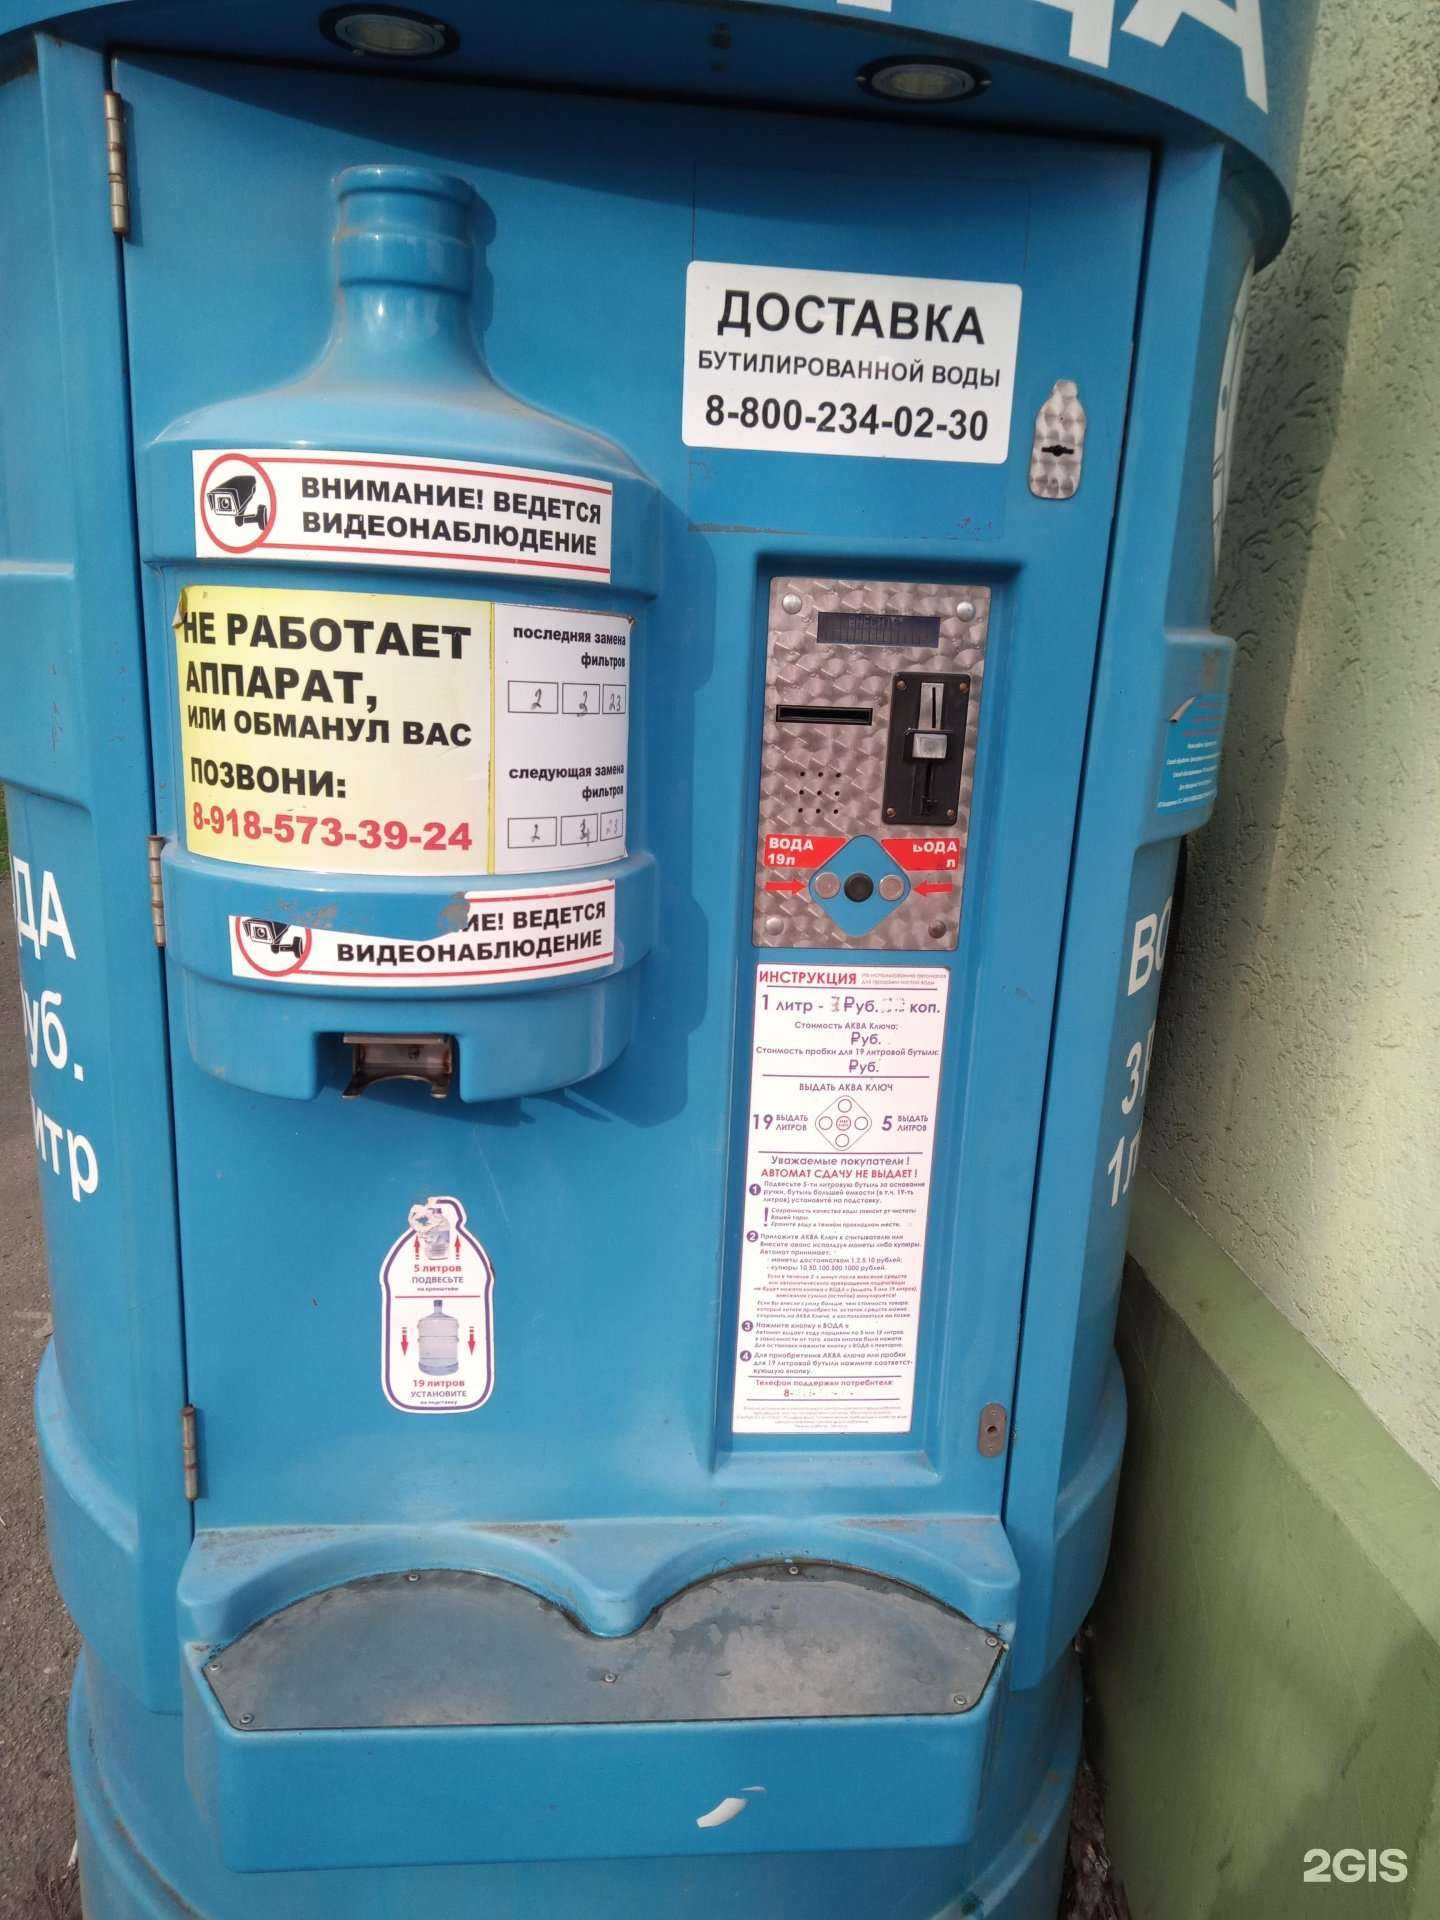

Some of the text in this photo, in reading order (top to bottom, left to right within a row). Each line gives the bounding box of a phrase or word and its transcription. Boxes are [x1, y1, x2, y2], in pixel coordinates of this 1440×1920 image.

[717, 289, 985, 345] ДОСТАВКА
[698, 350, 1000, 389] БУТИЛИРОВАННОЙ ВОДЫ
[705, 394, 988, 442] 8-800-234-02-30
[301, 476, 602, 525] ВНИМАНИЕ! ВЕДЕТСЯ
[302, 511, 597, 556] ВИДЕОНАБЛЮДЕНИЕ
[182, 611, 471, 660] НЕ РАБОТАЕТ
[513, 626, 626, 646] последняя замена
[581, 651, 626, 670] фильтров
[186, 660, 377, 713] АППАРАТ,
[187, 705, 472, 748] ИЛИ ОБМАНУЛ ВАС
[190, 756, 347, 799] ПОЗВОНИ:
[508, 763, 625, 781] следующая замена
[582, 785, 624, 802] фильтров
[193, 801, 473, 851] 8-918-573-39-24
[768, 837, 814, 852] ВОДА
[767, 853, 796, 866] 19л
[513, 901, 606, 930] ВЕДЕТСЯ
[337, 929, 602, 967] ВИДЕОНАБЛЮДЕНИЕ
[759, 971, 857, 985] ИНСТРУКЦИЯ
[762, 994, 769, 1011] 1
[776, 1001, 813, 1014] литр
[910, 1002, 941, 1014] коп.
[794, 1021, 843, 1031] Стоимость
[845, 1021, 867, 1031] АКВА
[756, 1046, 804, 1056] Стоимость
[805, 1047, 837, 1057] пробки
[866, 1048, 906, 1057] литровой
[799, 1083, 894, 1093] ВЫДАТЬ АКВА КЛЮЧ
[753, 1113, 809, 1131] 19 ВЫДАТЬ
[776, 1123, 807, 1132] ЛИТРОВ
[881, 1115, 929, 1132] 5 ВЫДАТЬ
[897, 1124, 928, 1133] ЛИТРОВ
[771, 1156, 838, 1166] Уважаемые
[840, 1157, 904, 1168] покупатели
[761, 1168, 812, 1178] АВТОМАТ
[814, 1169, 853, 1179] СДАЧУ
[855, 1170, 869, 1178] НЕ
[871, 1169, 913, 1179] ВЫДАЕТ
[422, 1265, 462, 1274] литров
[411, 1276, 465, 1285] ПОДВЕСЬТЕ
[413, 1379, 465, 1389] 19 литров
[411, 1390, 468, 1398] УСТАНОВИТЕ
